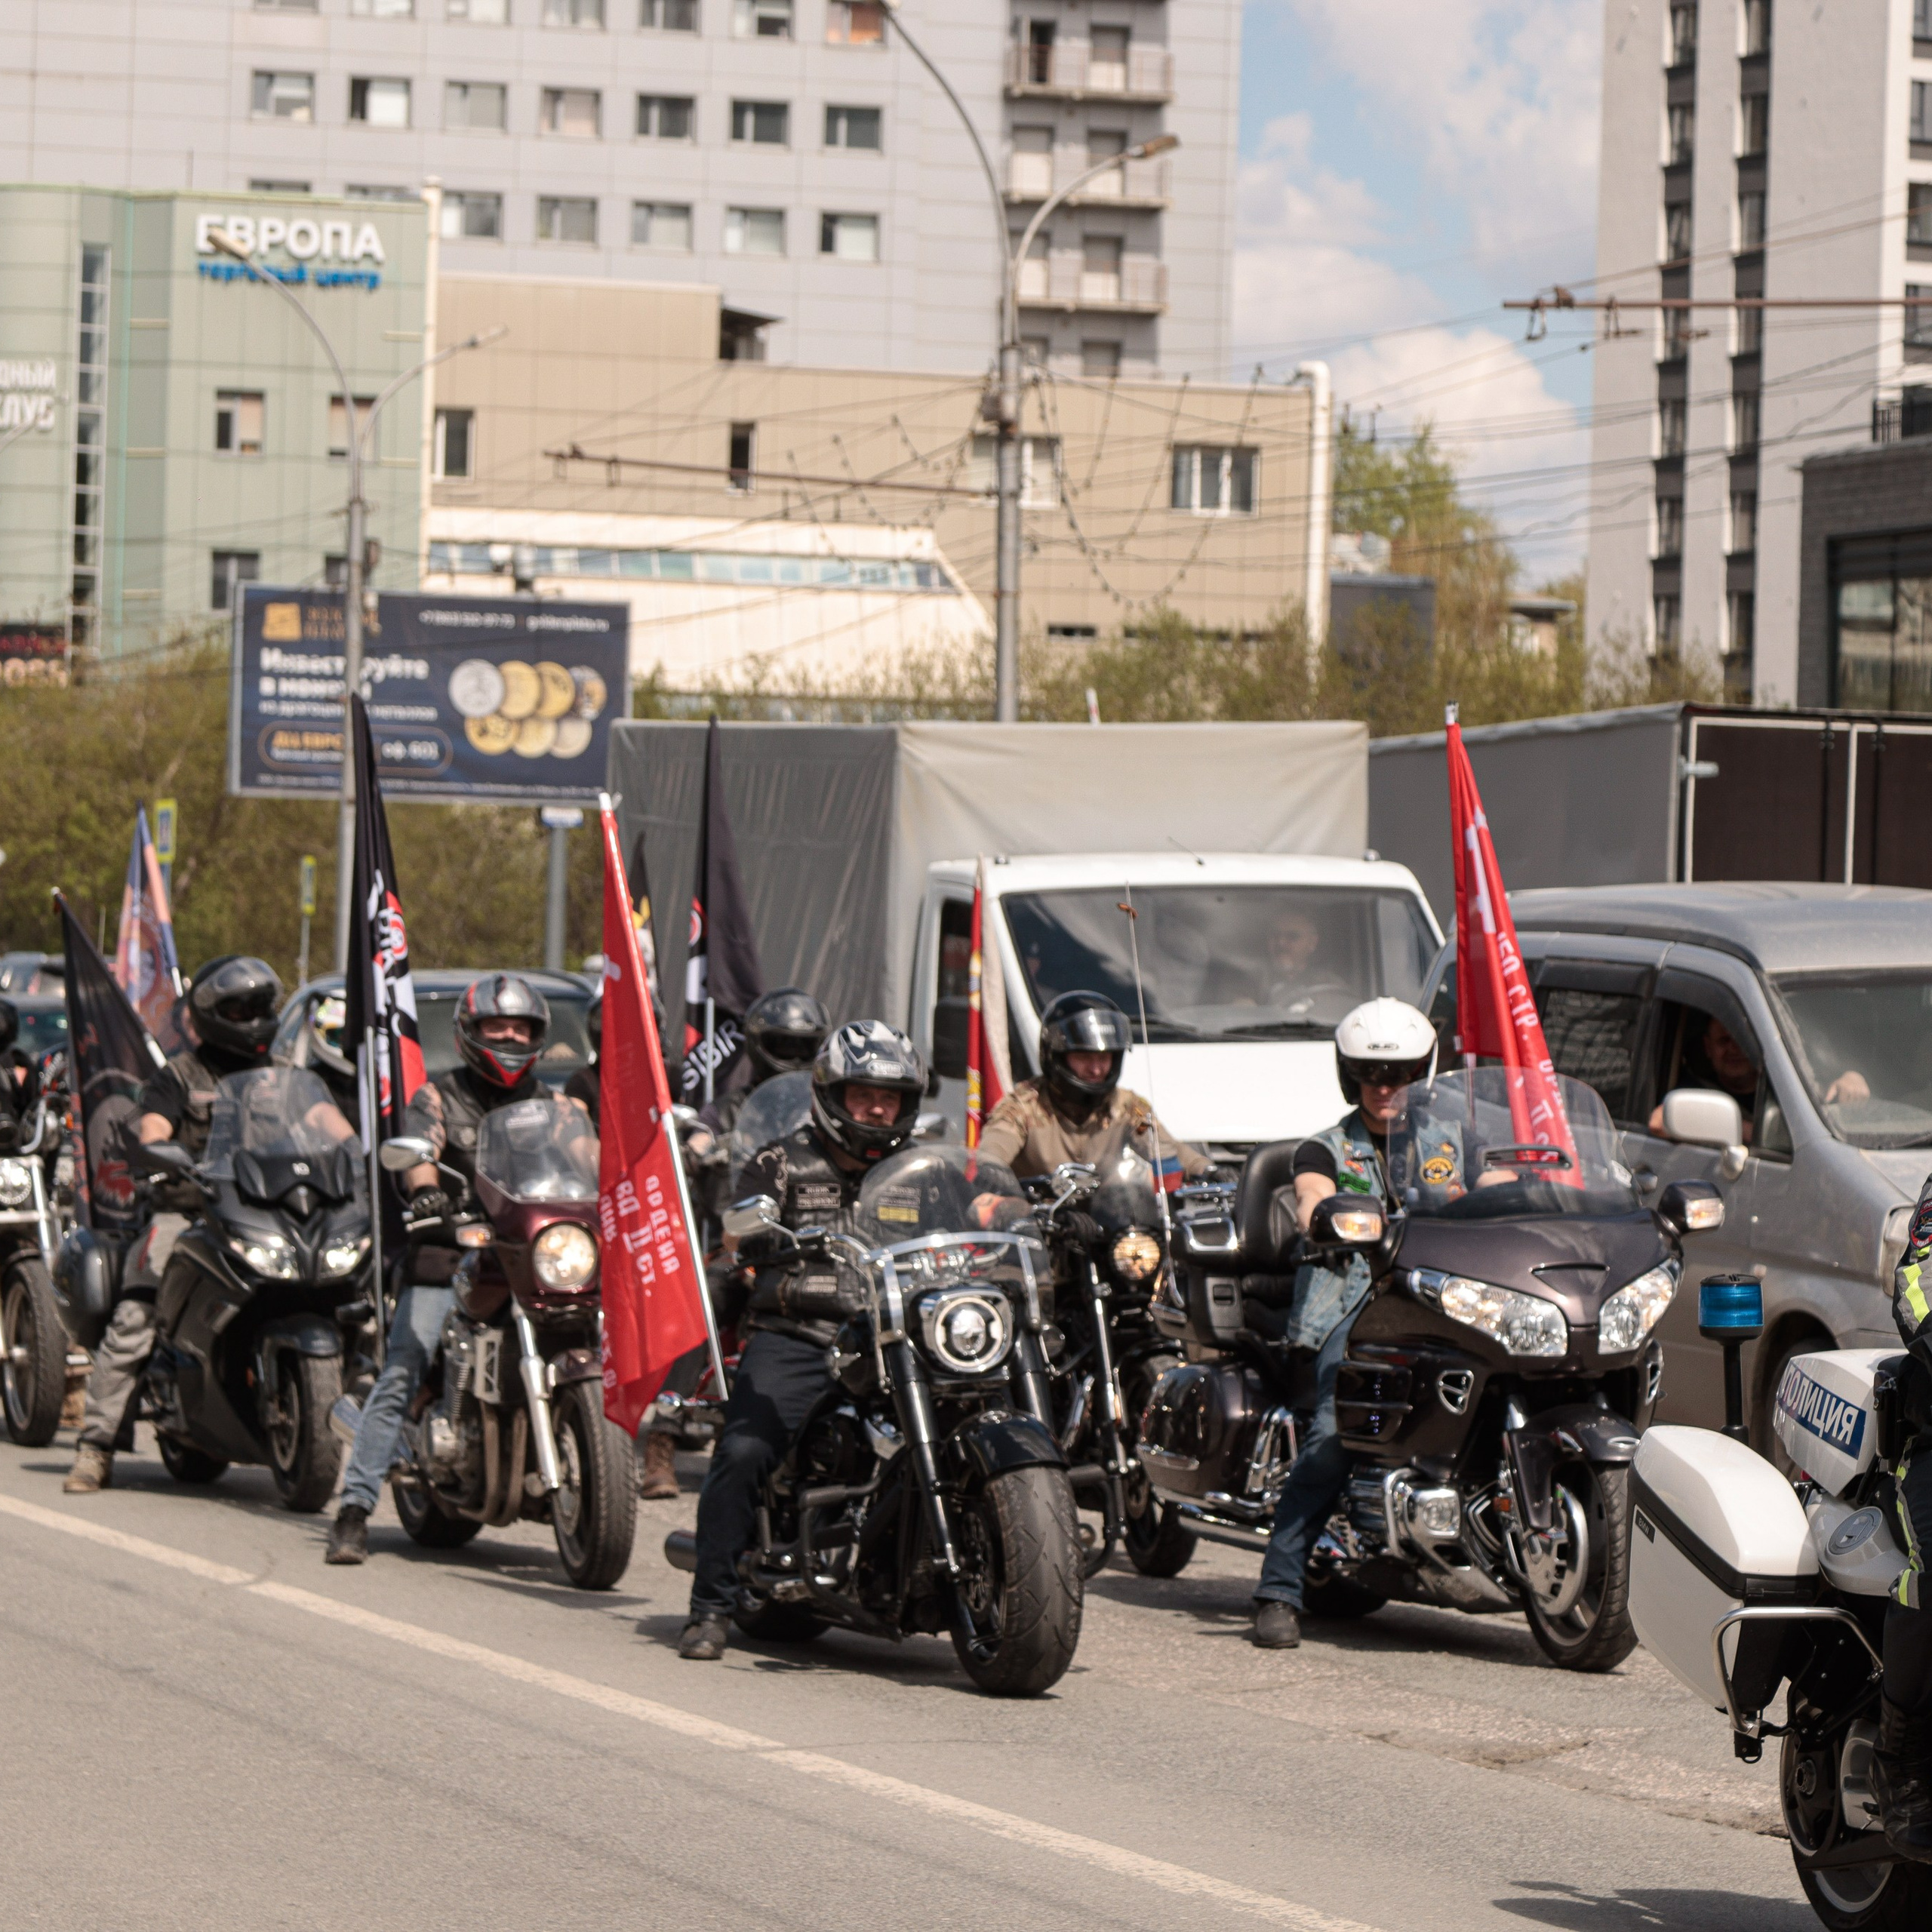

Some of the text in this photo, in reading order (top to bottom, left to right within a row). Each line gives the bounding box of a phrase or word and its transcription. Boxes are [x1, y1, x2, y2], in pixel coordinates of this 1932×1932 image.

[196, 214, 386, 263] ЕВРОПА
[681, 1020, 746, 1091] SIBIR
[1780, 1364, 1860, 1445] ПОЛИЦИЯ
[1638, 1517, 1650, 1535] BMW
